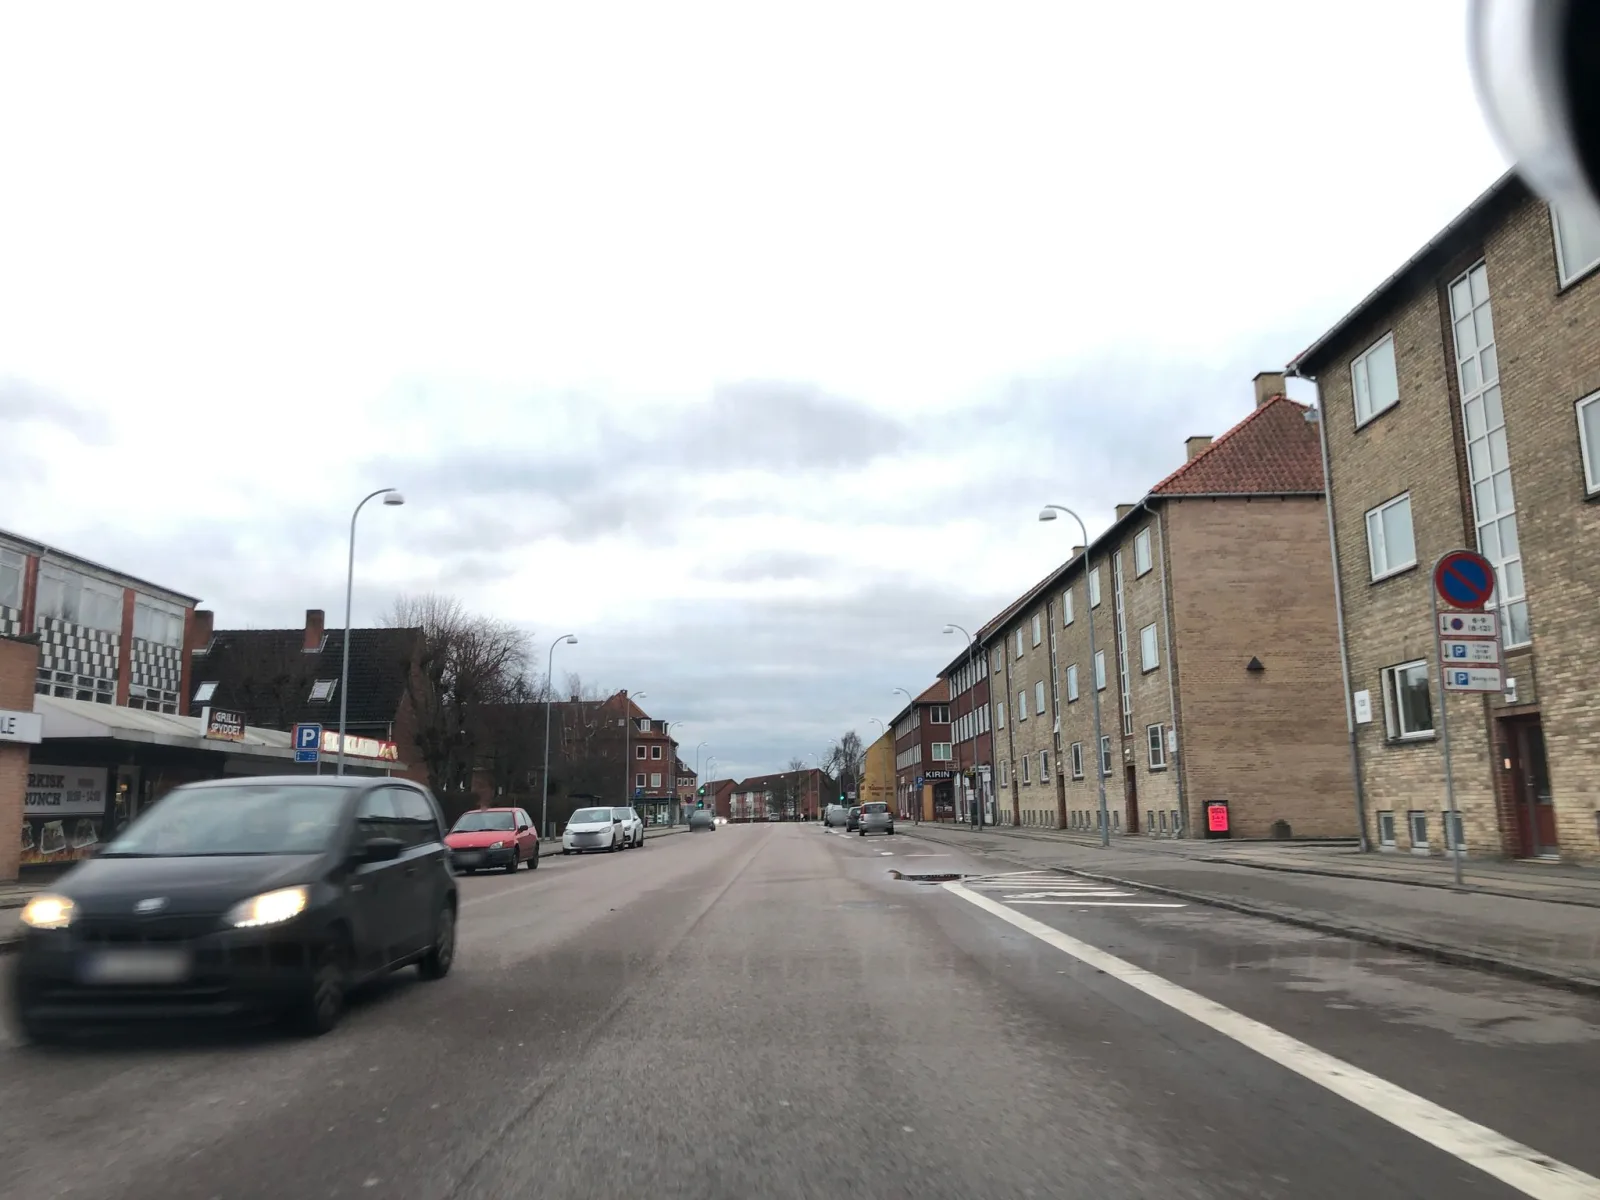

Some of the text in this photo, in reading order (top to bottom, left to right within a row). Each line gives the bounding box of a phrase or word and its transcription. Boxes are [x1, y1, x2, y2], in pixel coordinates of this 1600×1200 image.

[215, 711, 238, 724] GRILL
[0, 717, 16, 734] LE
[211, 722, 240, 736] SPYDDET
[302, 728, 315, 747] P
[27, 773, 65, 788] RKISK
[925, 770, 950, 778] KIRIN
